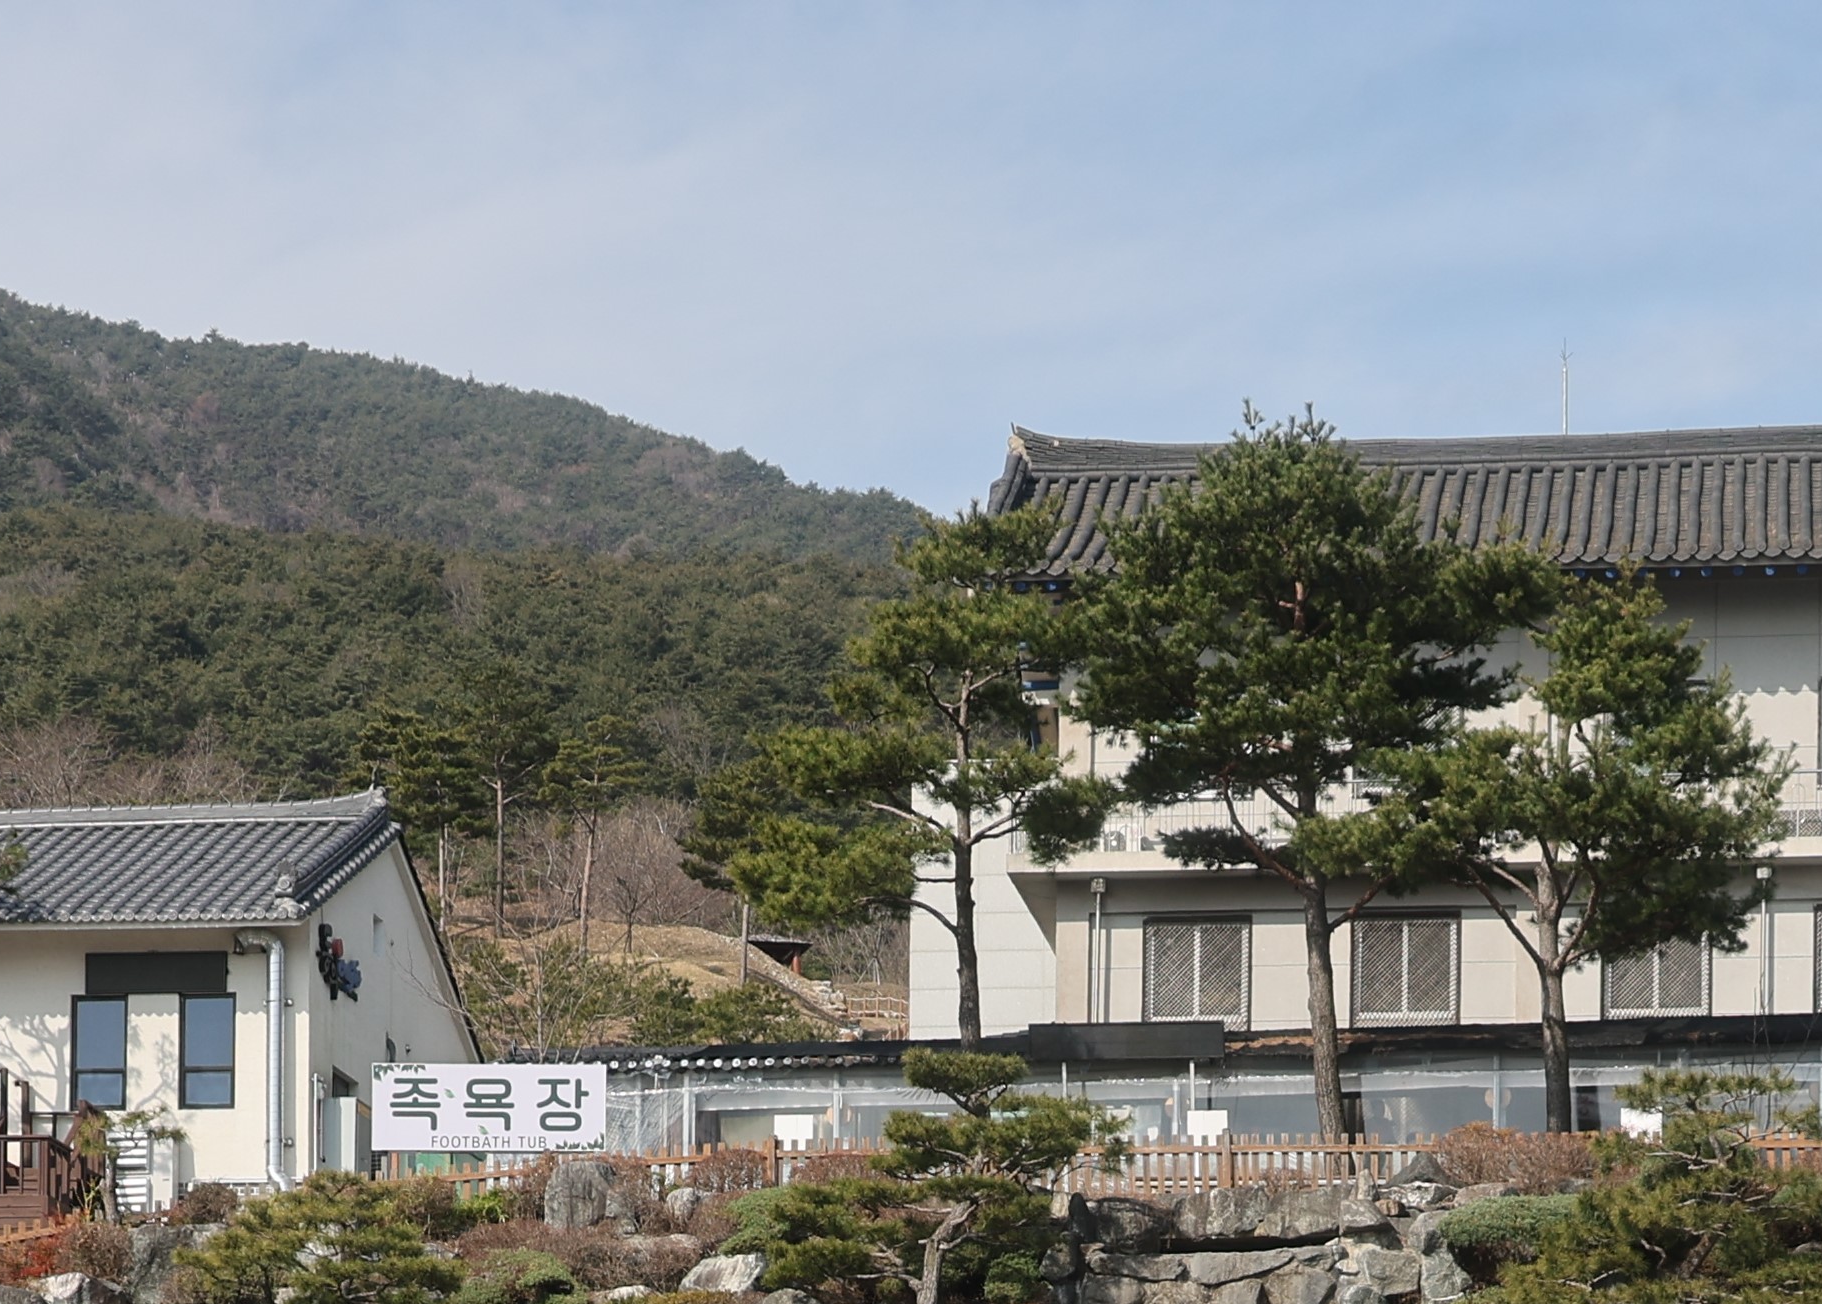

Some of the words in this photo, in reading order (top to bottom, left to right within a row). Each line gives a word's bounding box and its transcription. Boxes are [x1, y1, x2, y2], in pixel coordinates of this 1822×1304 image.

[389, 1077, 589, 1132] 족욕장
[430, 1135, 511, 1150] FOOTBATH
[518, 1135, 547, 1150] TUB
